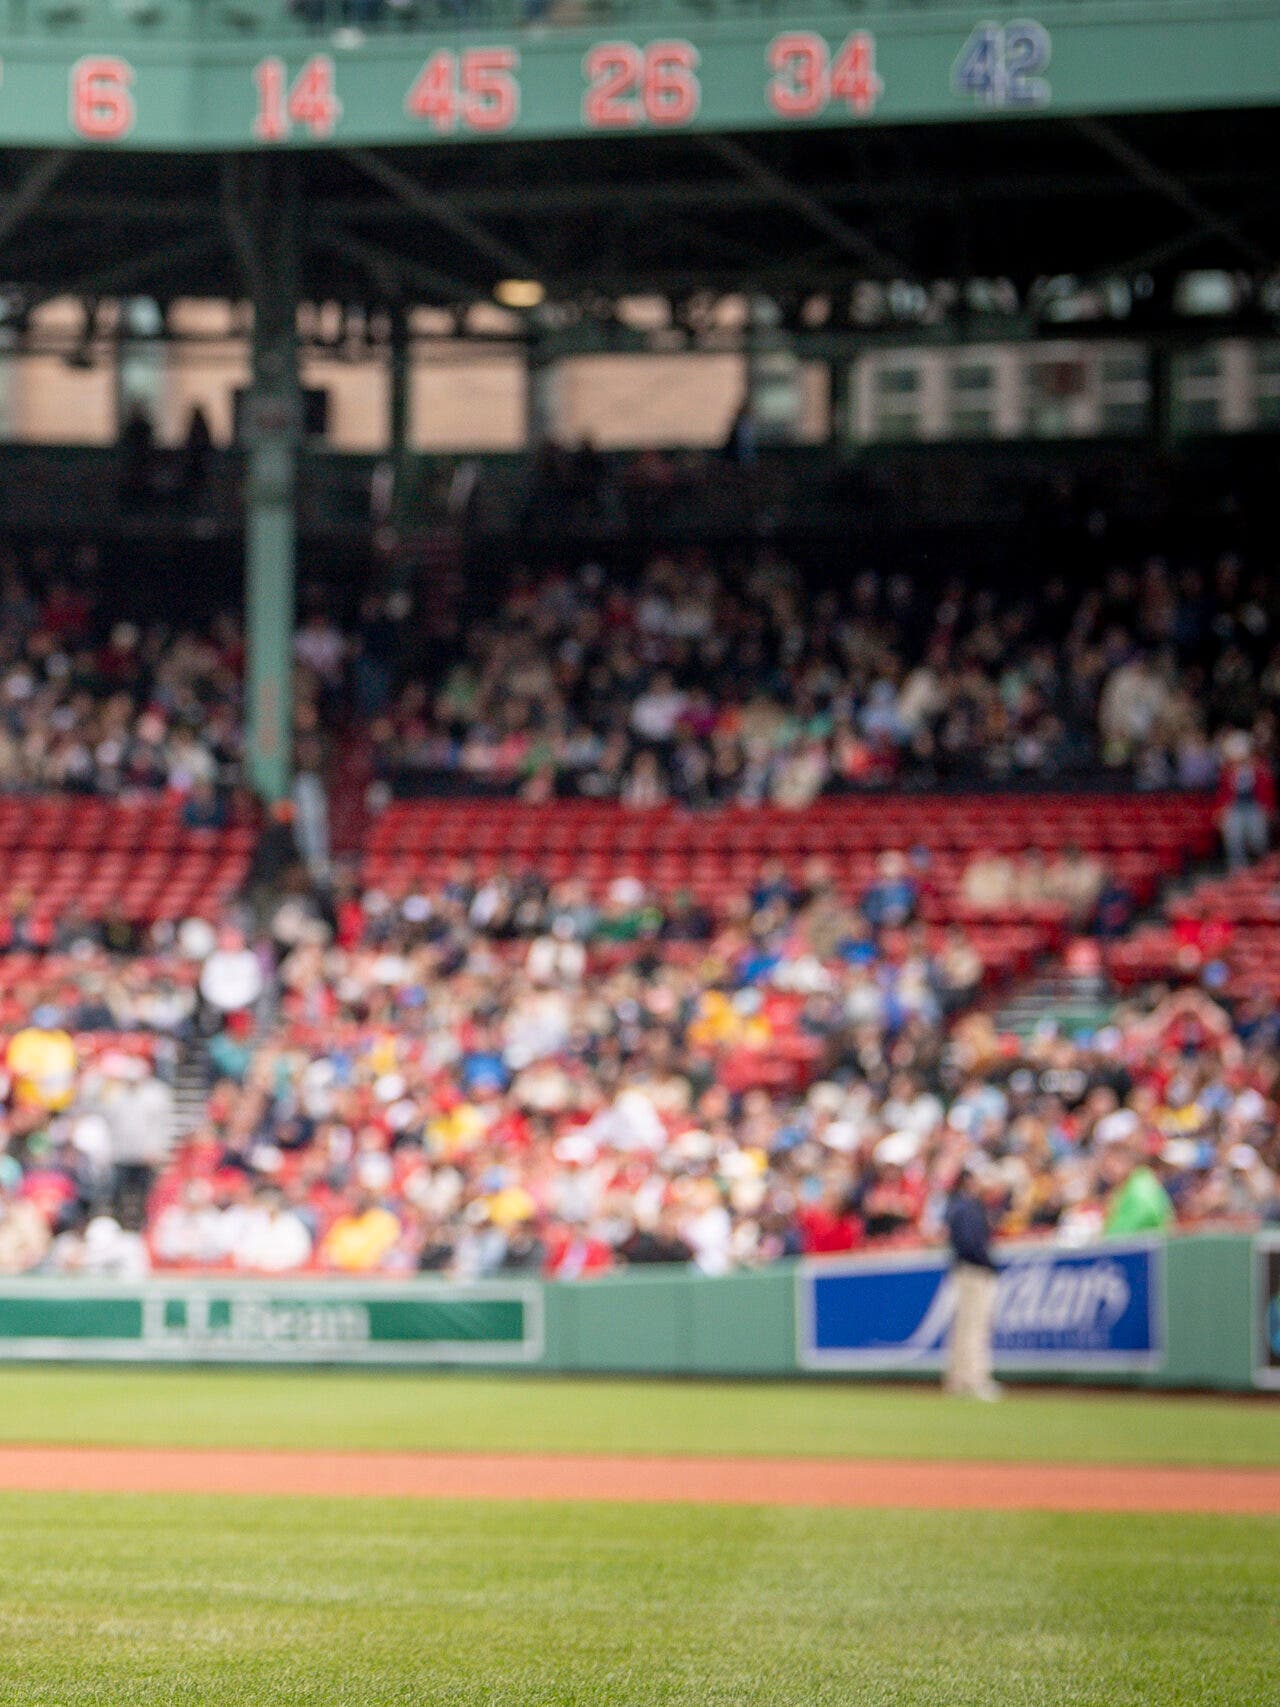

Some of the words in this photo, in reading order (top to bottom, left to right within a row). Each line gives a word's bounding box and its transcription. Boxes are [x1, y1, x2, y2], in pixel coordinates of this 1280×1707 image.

[71, 55, 135, 142] 6
[253, 55, 339, 144] 14
[405, 48, 517, 134] 45
[583, 39, 701, 129] 26
[767, 29, 883, 118] 34
[952, 20, 1052, 109] 42
